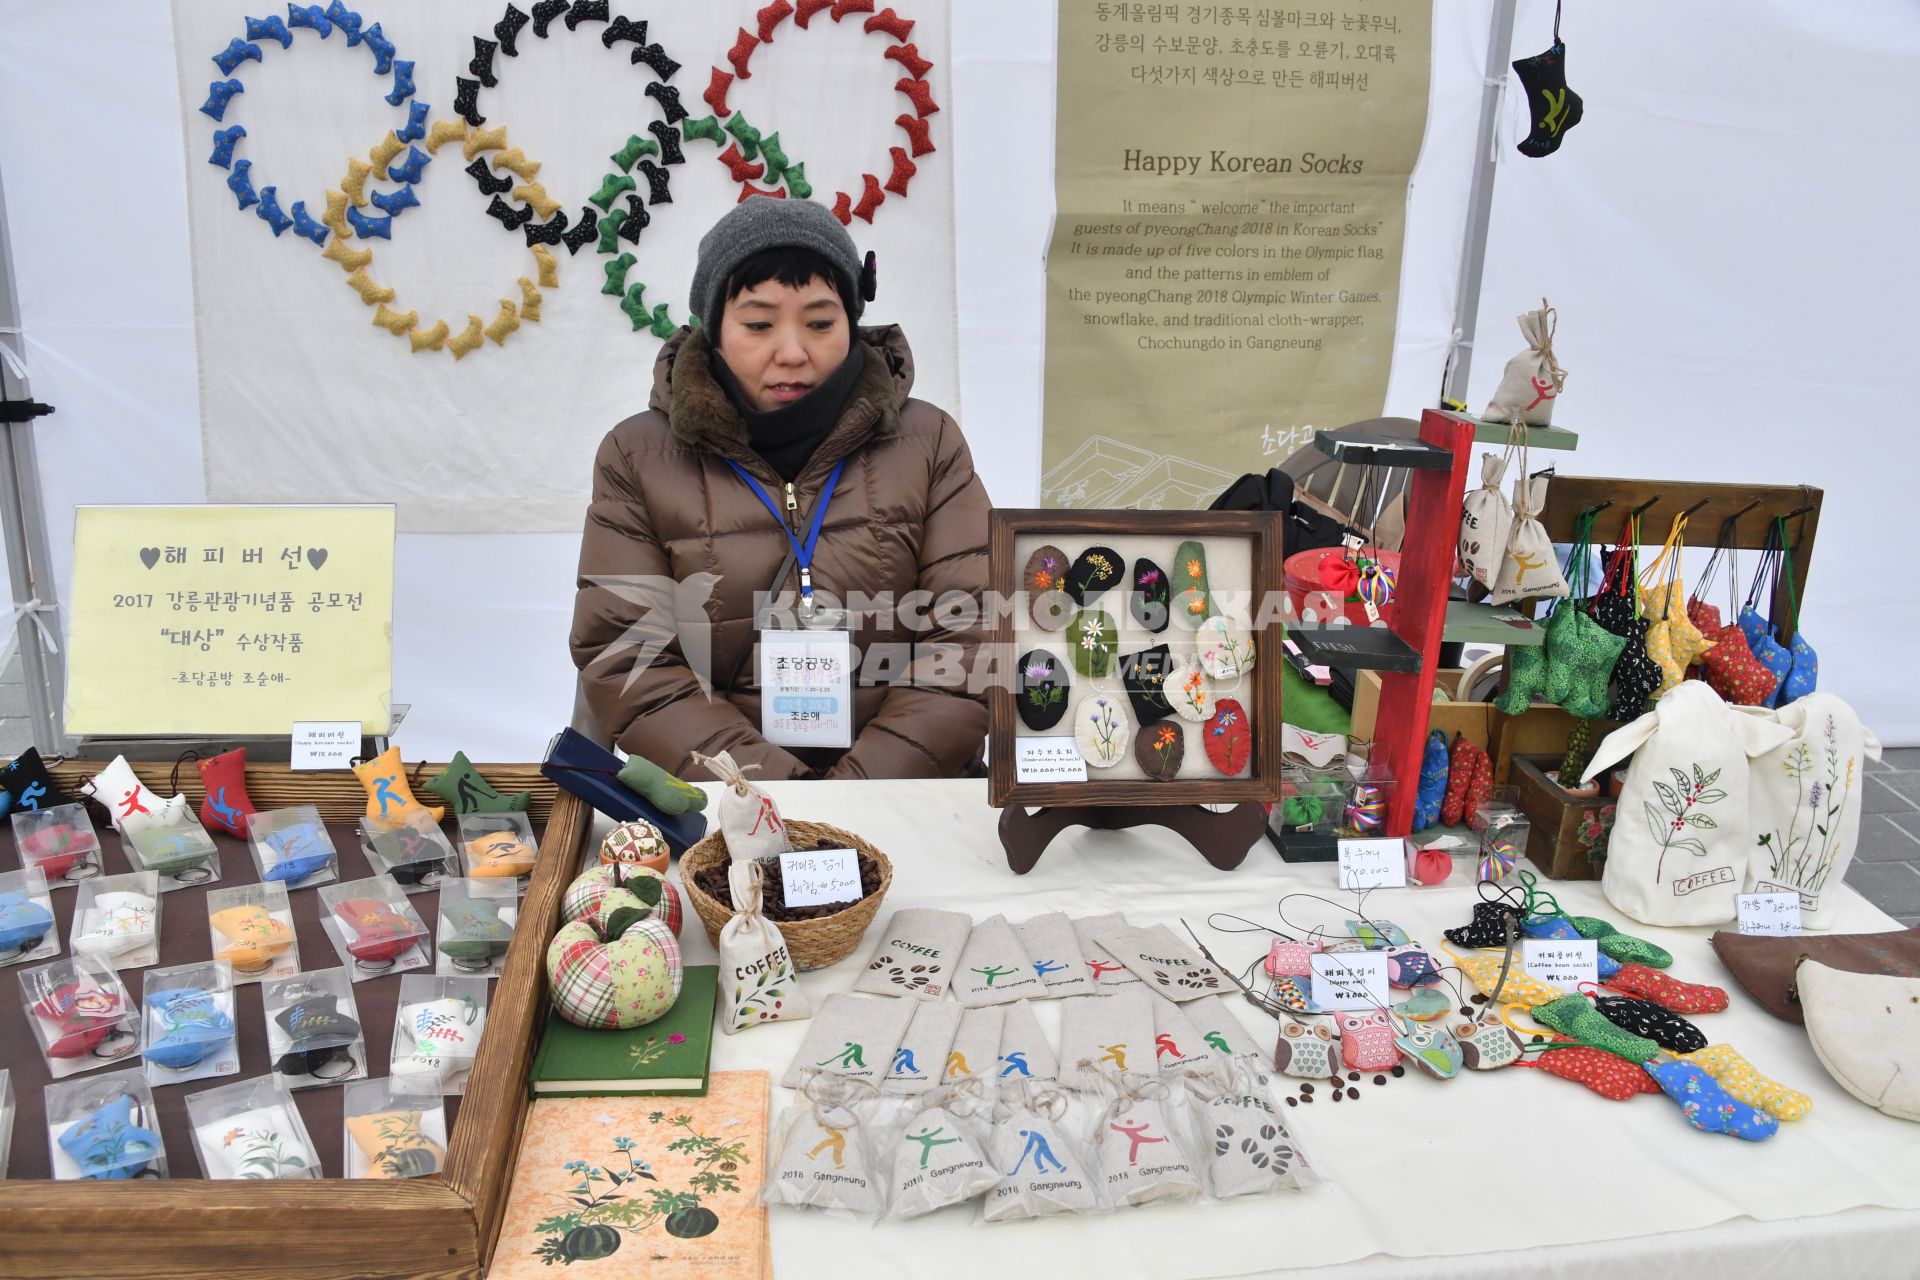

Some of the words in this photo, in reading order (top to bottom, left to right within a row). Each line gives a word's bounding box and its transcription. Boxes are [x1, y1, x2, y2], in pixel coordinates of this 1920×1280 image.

[1094, 2, 1179, 23] 동계올림픽
[1186, 5, 1251, 27] 경기종목
[1256, 8, 1336, 30] 심볼마크와
[1095, 32, 1145, 54] 강릉의
[1228, 37, 1291, 59] 초충도를
[1354, 44, 1397, 64] 오대륙
[1131, 64, 1196, 86] 다섯가지
[1202, 66, 1266, 87] 색상으로
[1272, 69, 1304, 89] 만든
[1309, 70, 1369, 92] 해피버선
[1122, 149, 1202, 176] Happy
[1209, 150, 1293, 173] Korean
[1299, 151, 1364, 175] Socks
[1122, 199, 1133, 213] It
[1138, 201, 1186, 214] means
[1269, 200, 1290, 214] the
[1293, 200, 1355, 217] important
[1073, 222, 1122, 236] guests
[1125, 221, 1142, 235] of
[1143, 222, 1239, 238] pyeongChang
[1241, 221, 1274, 236] 2018
[1276, 222, 1289, 236] in
[1293, 222, 1341, 237] Korean
[1070, 241, 1082, 254] It
[1086, 241, 1099, 255] is
[1102, 243, 1143, 257] made
[1146, 245, 1165, 259] up
[1168, 243, 1183, 257] of
[1185, 243, 1212, 257] five
[1215, 243, 1259, 258] colors
[1263, 244, 1277, 259] in
[1281, 245, 1302, 259] the
[1305, 246, 1354, 261] Olympic
[1357, 245, 1385, 261] flag
[1125, 265, 1153, 280] and
[1157, 266, 1180, 280] the
[1184, 266, 1243, 283] patterns
[1247, 268, 1260, 281] in
[1263, 268, 1314, 282] emblem
[1317, 268, 1331, 281] of
[1068, 287, 1092, 301] the
[1095, 288, 1193, 306] pyeongChang
[1196, 289, 1229, 304] 2018
[1232, 290, 1287, 307] Olympic
[1290, 290, 1335, 304] Winter
[1163, 313, 1189, 327] and
[1194, 313, 1264, 327] traditional
[1137, 335, 1226, 352] Chochungdo
[1229, 336, 1242, 350] in
[1246, 335, 1323, 351] Gangneung
[1522, 581, 1560, 594] Gangneung
[112, 593, 154, 609] 2017
[166, 591, 296, 613] 강릉관광기념품
[307, 591, 363, 613] 공모전
[160, 628, 225, 652] “대상”
[236, 632, 305, 654] 수상작품
[776, 656, 834, 671] 초당공방
[790, 711, 820, 721] 조순애
[1677, 869, 1728, 893] COFFEE
[890, 938, 942, 959] COFFEE
[735, 945, 788, 981] COFFEE
[1139, 953, 1192, 967] COFFEE
[411, 1057, 441, 1068] 2018
[1163, 1054, 1209, 1069] Gangneung
[781, 1170, 805, 1180] 2018
[813, 1171, 867, 1188] Gangneung
[901, 1175, 924, 1191] 2018
[930, 1159, 984, 1179] Gangneung
[1107, 1171, 1129, 1183] 2018
[1138, 1164, 1190, 1177] Gangneung
[996, 1185, 1020, 1198] 2018
[1029, 1180, 1083, 1193] Gangneung
